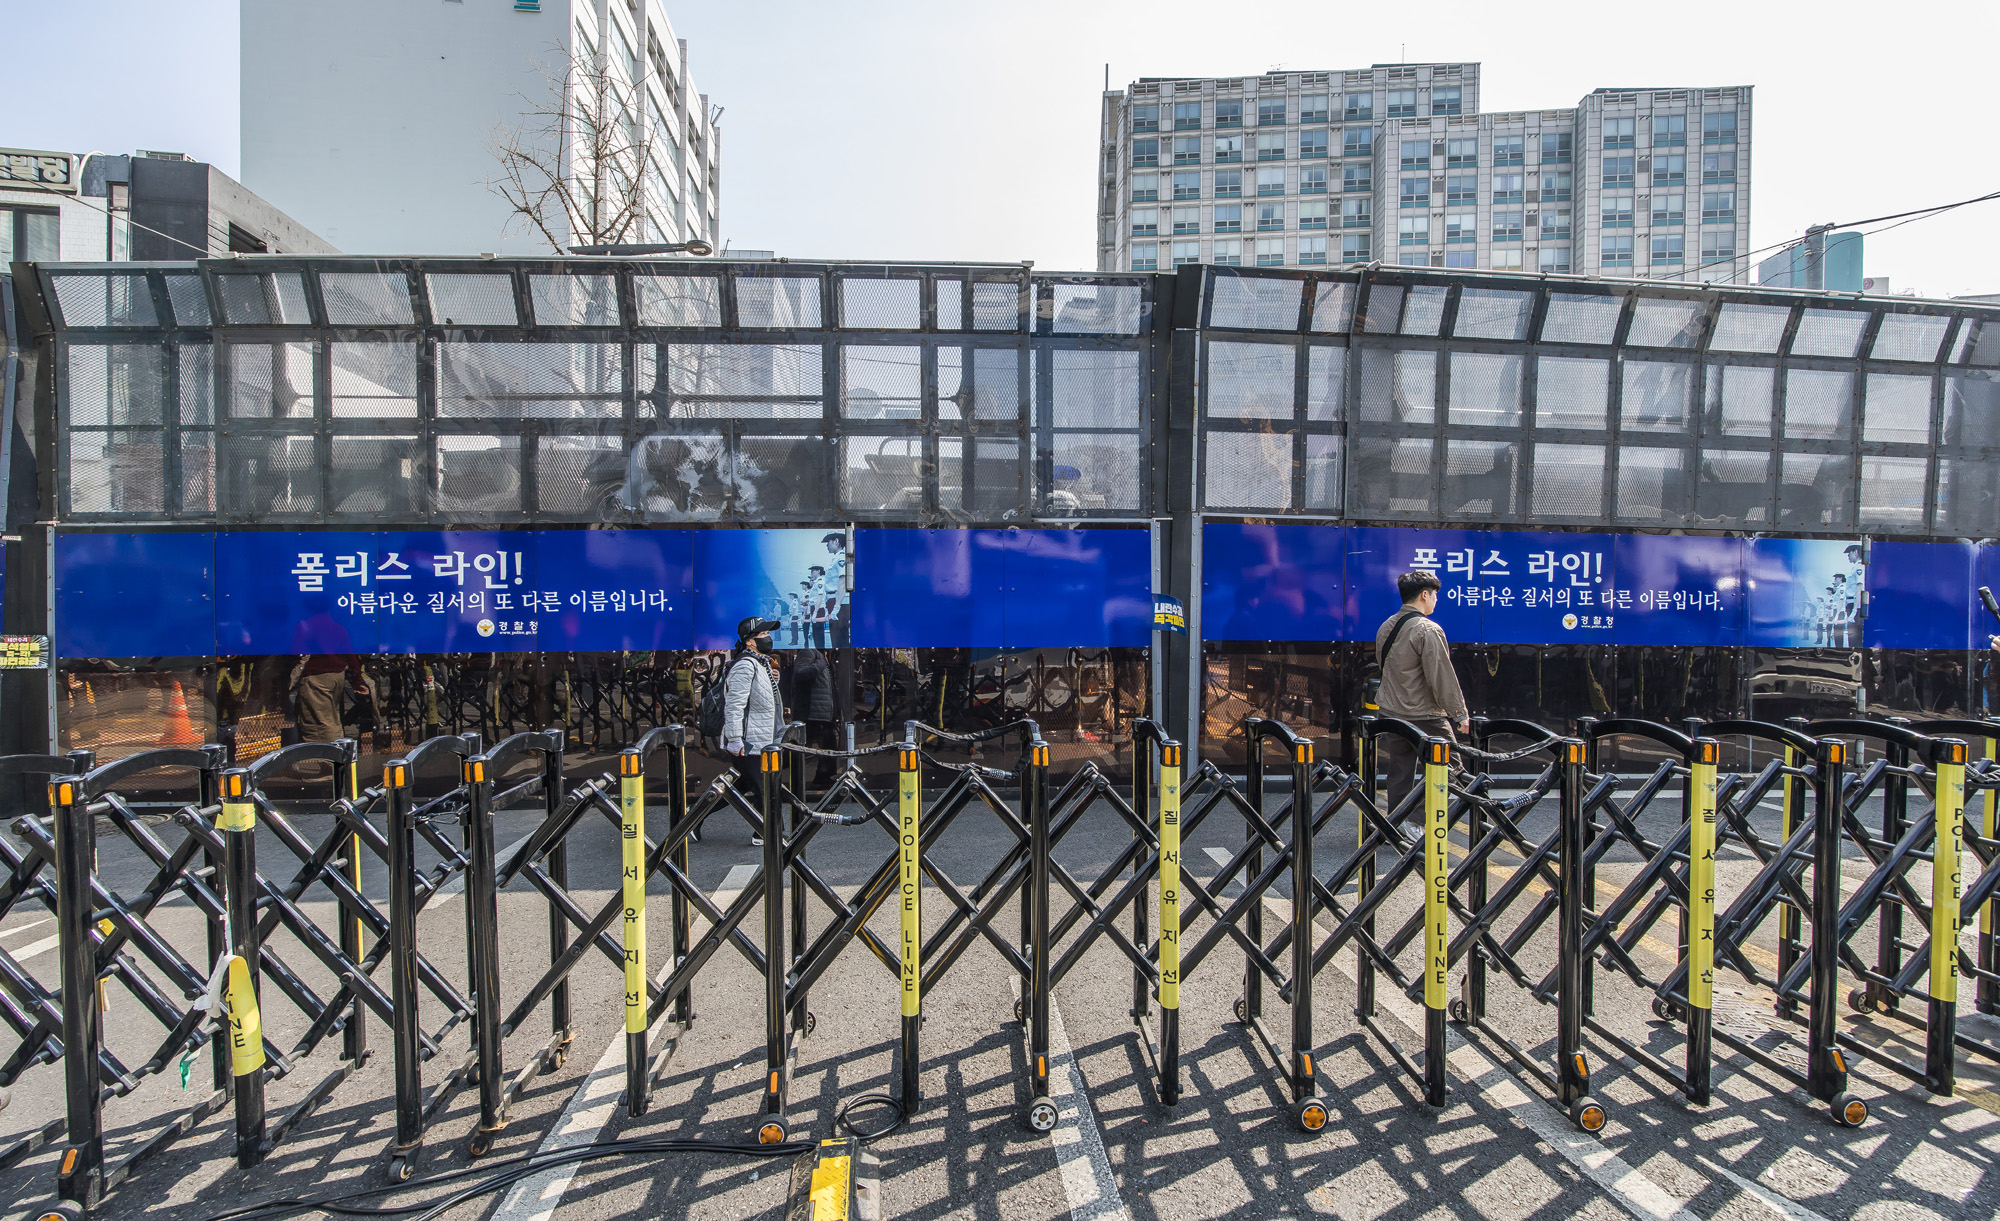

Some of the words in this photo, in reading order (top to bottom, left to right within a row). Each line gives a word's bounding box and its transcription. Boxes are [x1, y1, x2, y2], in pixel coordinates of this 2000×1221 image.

[291, 551, 412, 592] 폴리스
[432, 550, 523, 589] 라인!
[1447, 585, 1516, 608] 아름다운
[1521, 587, 1571, 609] 질서의
[1577, 590, 1595, 606] 또
[1600, 588, 1634, 610] 다른
[1639, 589, 1724, 612] 이름입니다.
[1528, 550, 1603, 587] 라인!
[337, 591, 419, 615] 아름다운
[426, 591, 485, 614] 질서의
[494, 593, 515, 610] 또
[521, 590, 562, 613] 다른
[569, 589, 673, 613] 이름입니다.
[903, 816, 915, 911] POLICE
[1434, 809, 1447, 904] POLICE
[622, 823, 639, 1007] 질서유지선
[1162, 809, 1179, 985] 질서유지선
[904, 930, 915, 992] LINE
[1435, 922, 1446, 984] LINE
[228, 993, 246, 1048] INE
